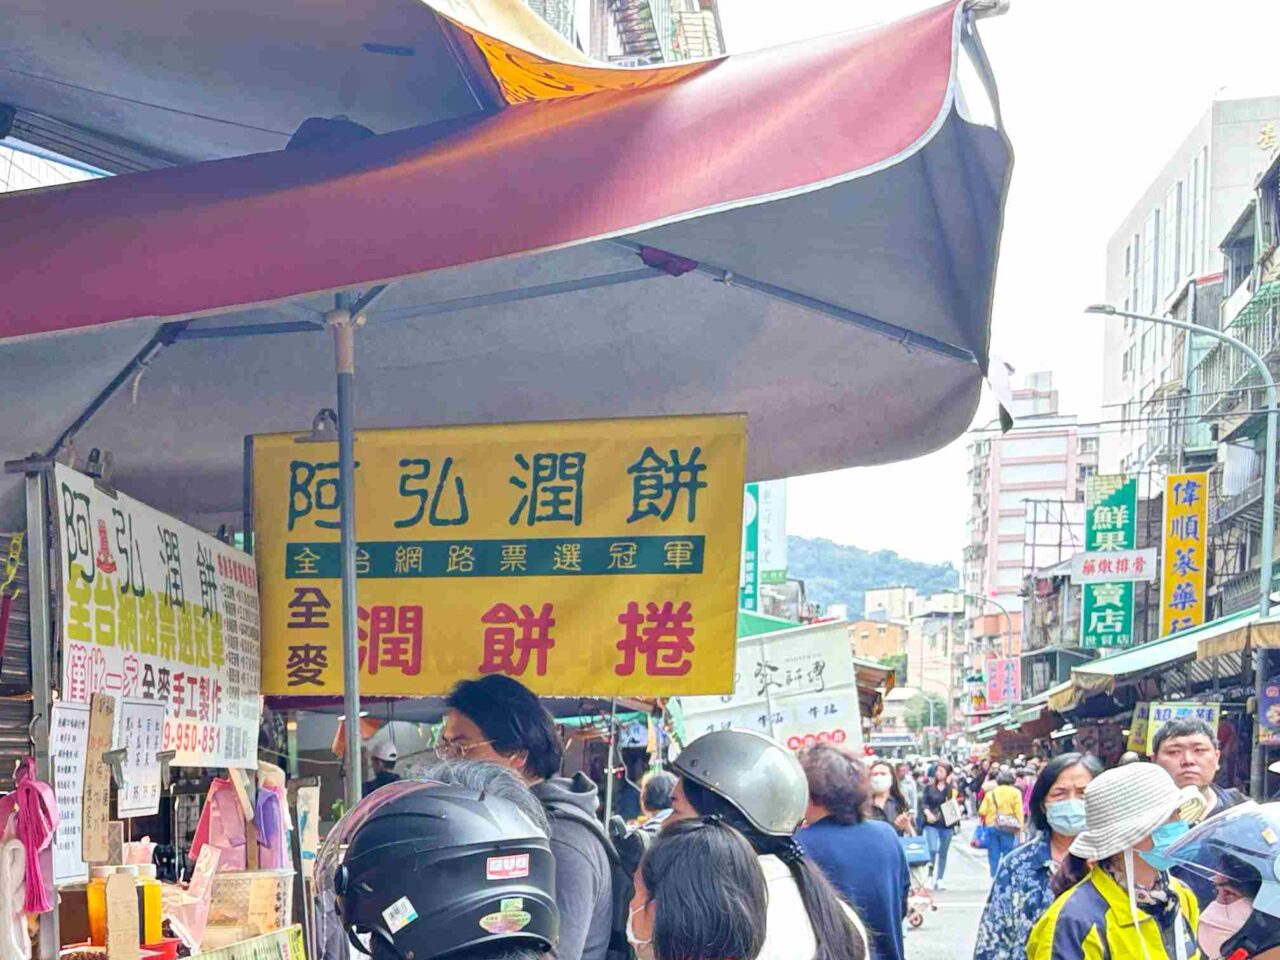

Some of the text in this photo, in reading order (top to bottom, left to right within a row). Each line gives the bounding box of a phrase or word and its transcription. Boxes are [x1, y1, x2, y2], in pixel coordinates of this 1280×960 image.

[287, 446, 708, 533] 阿弘潤餅
[62, 482, 219, 623] 阿弘潤餅
[1088, 505, 1129, 633] 鮮果賣店
[287, 587, 330, 687] 全麥
[357, 601, 696, 678] 潤餅捲
